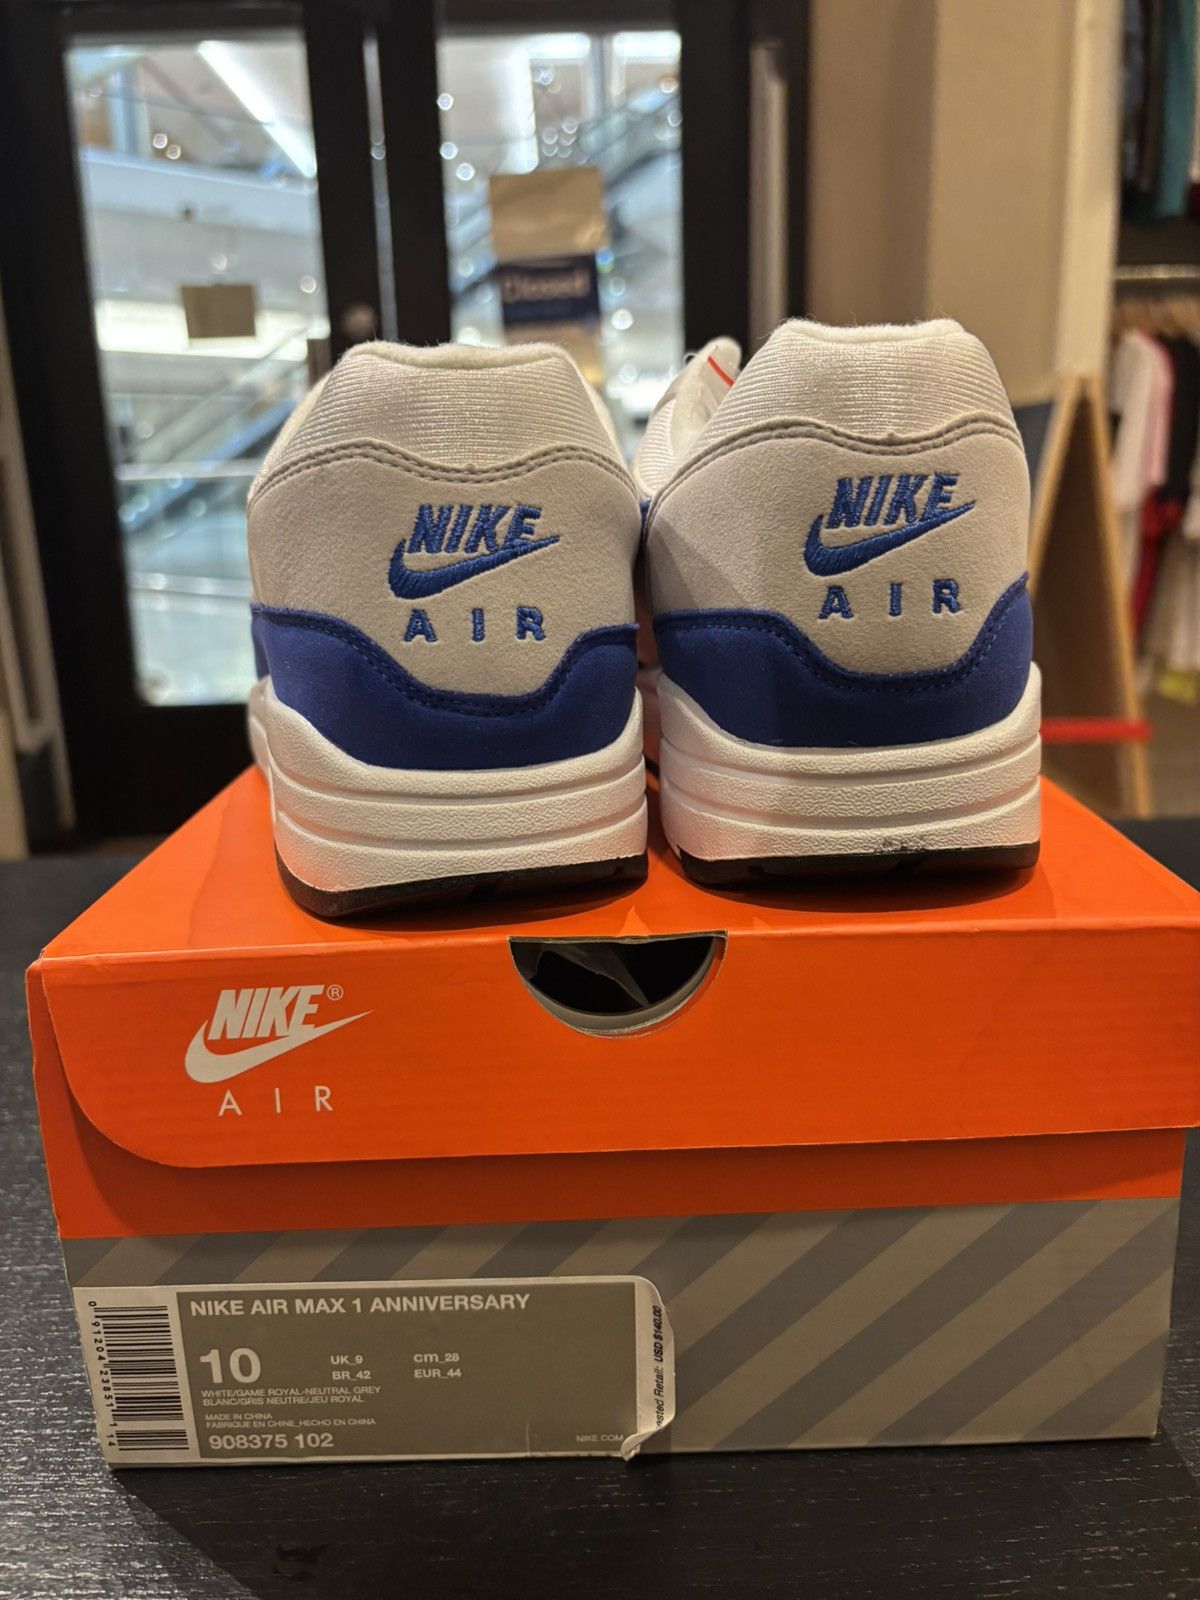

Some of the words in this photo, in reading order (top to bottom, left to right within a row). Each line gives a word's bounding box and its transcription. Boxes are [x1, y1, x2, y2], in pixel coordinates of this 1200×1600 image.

[825, 472, 960, 530] NIKE
[407, 503, 543, 554] NIKE
[818, 578, 962, 619] AIR
[404, 606, 547, 643] AIR
[218, 1085, 334, 1117] AIR
[190, 1300, 245, 1317] NIKE
[251, 1299, 289, 1315] AIR
[295, 1298, 347, 1315] MAX
[352, 1297, 362, 1313] 1
[370, 1293, 531, 1313] ANNIVERSARY
[652, 1305, 665, 1341] $140.00
[91, 1321, 106, 1361] 91204
[99, 1370, 115, 1408] 23851
[199, 1347, 262, 1384] 10
[653, 1341, 665, 1363] USD
[201, 1388, 266, 1398] WHITE/GAME
[353, 1386, 381, 1395] GREY
[202, 1397, 265, 1407] BLANC/GRIS
[330, 1395, 365, 1403] ROYAL
[205, 1413, 231, 1421] MADE
[244, 1412, 273, 1420] CHINA
[206, 1420, 252, 1428] FABRIQUE
[253, 1420, 266, 1428] EN
[348, 1418, 376, 1426] CHINA
[208, 1433, 289, 1450] 908375
[294, 1432, 335, 1449] 102
[576, 1434, 624, 1443] NIKE.COM
